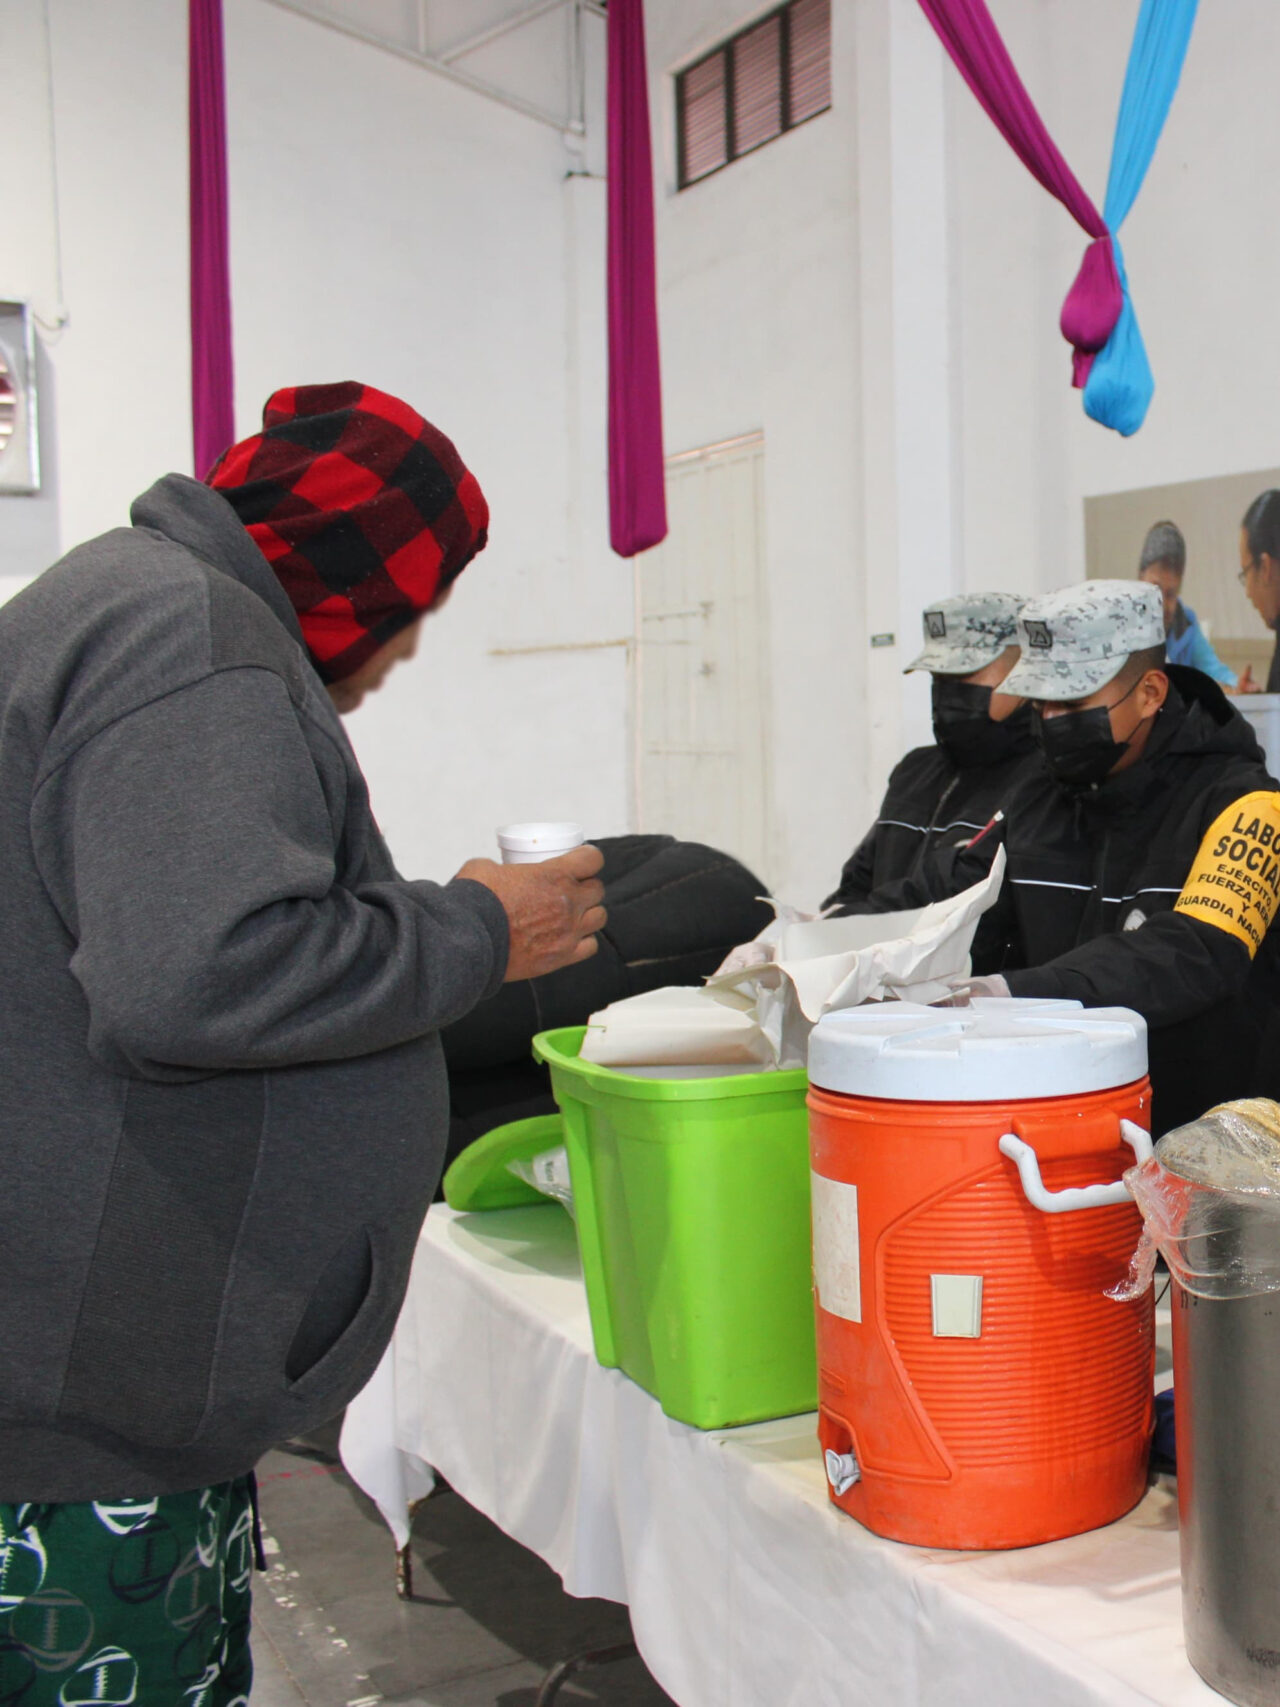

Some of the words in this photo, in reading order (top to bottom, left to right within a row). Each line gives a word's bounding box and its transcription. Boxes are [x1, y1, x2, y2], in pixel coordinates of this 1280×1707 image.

[1197, 873, 1252, 902] FUERZA
[1216, 863, 1272, 912] EJÉRCITO,
[1176, 895, 1234, 919] GUARDIA
[1241, 901, 1251, 913] Y
